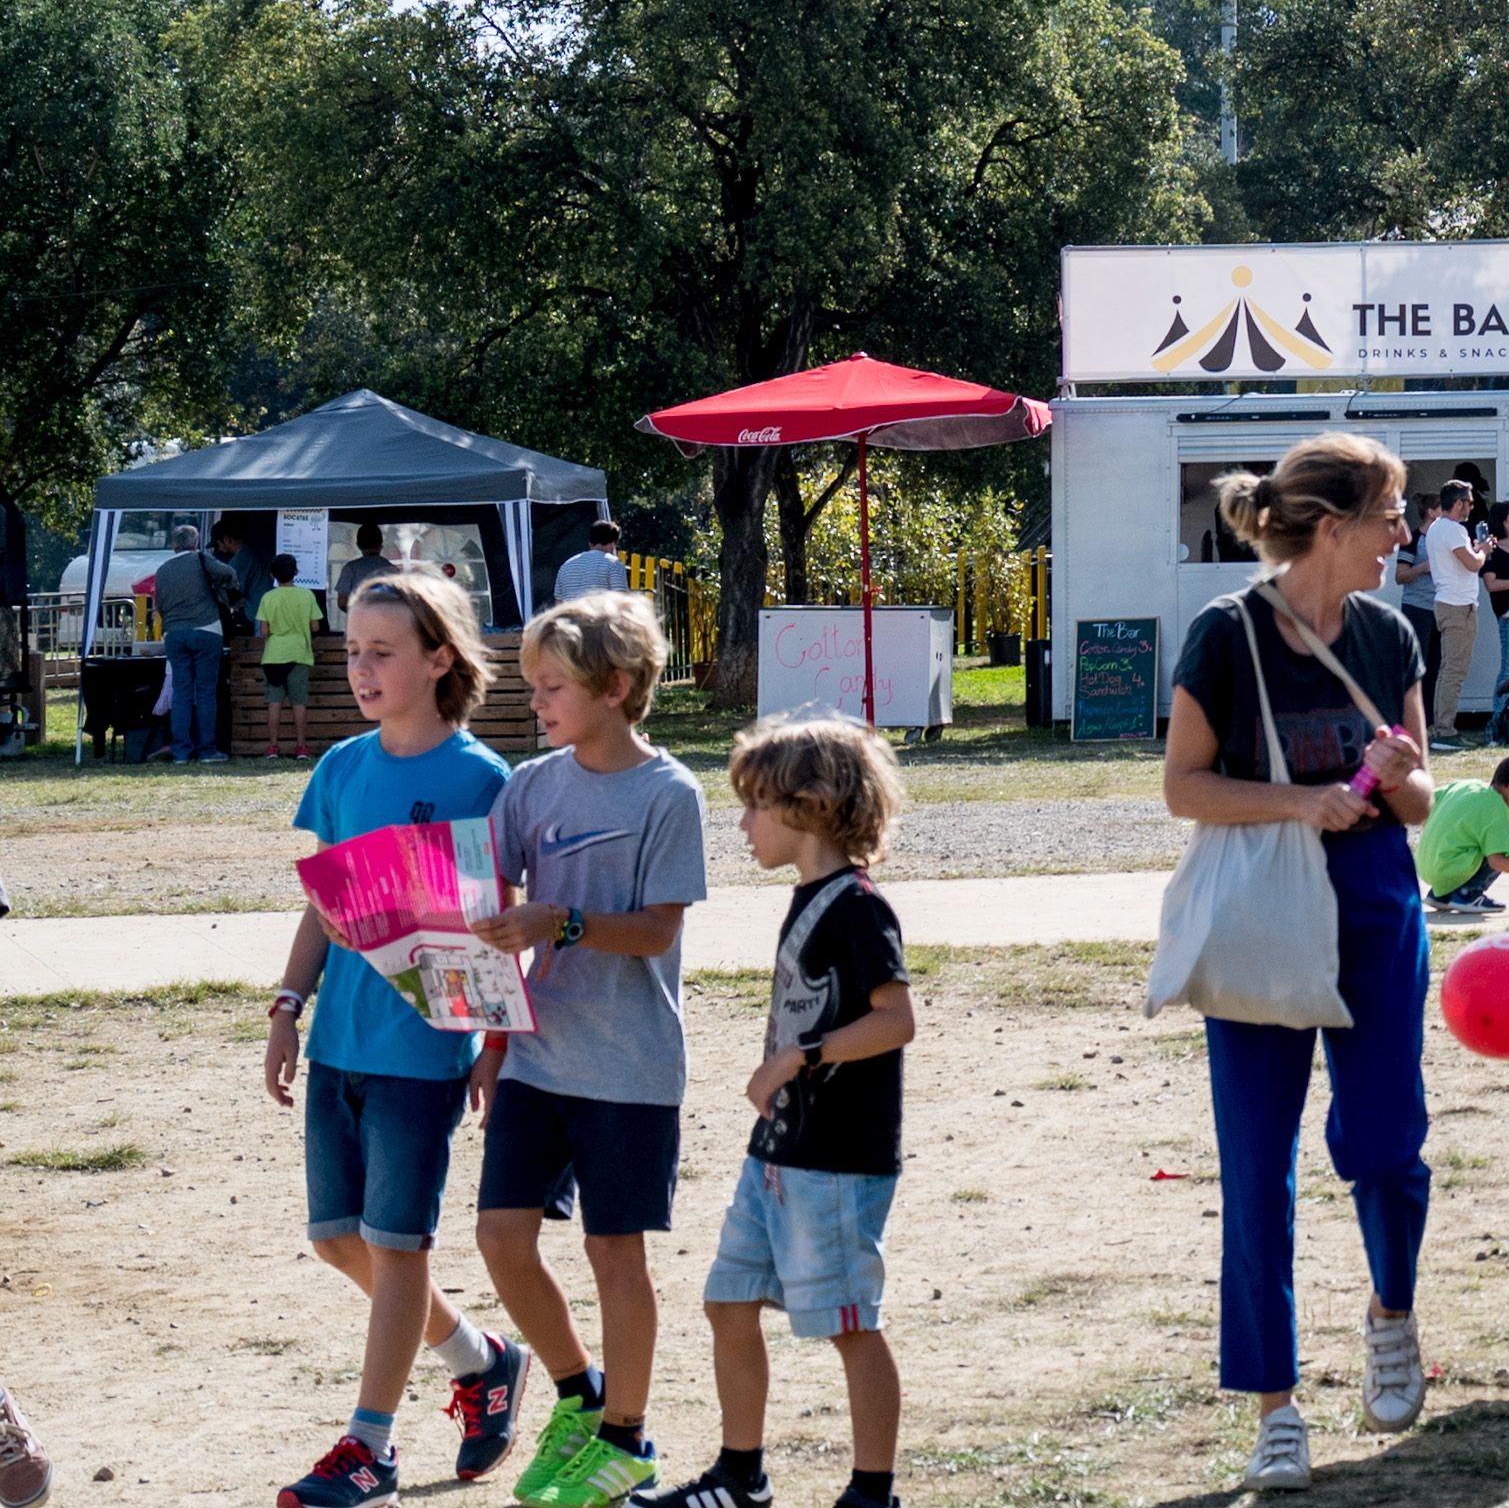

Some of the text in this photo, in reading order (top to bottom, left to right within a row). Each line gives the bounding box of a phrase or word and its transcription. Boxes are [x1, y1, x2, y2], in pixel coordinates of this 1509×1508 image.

[1352, 303, 1432, 337] THE
[1358, 348, 1428, 359] DRINKS
[1439, 348, 1448, 359] &
